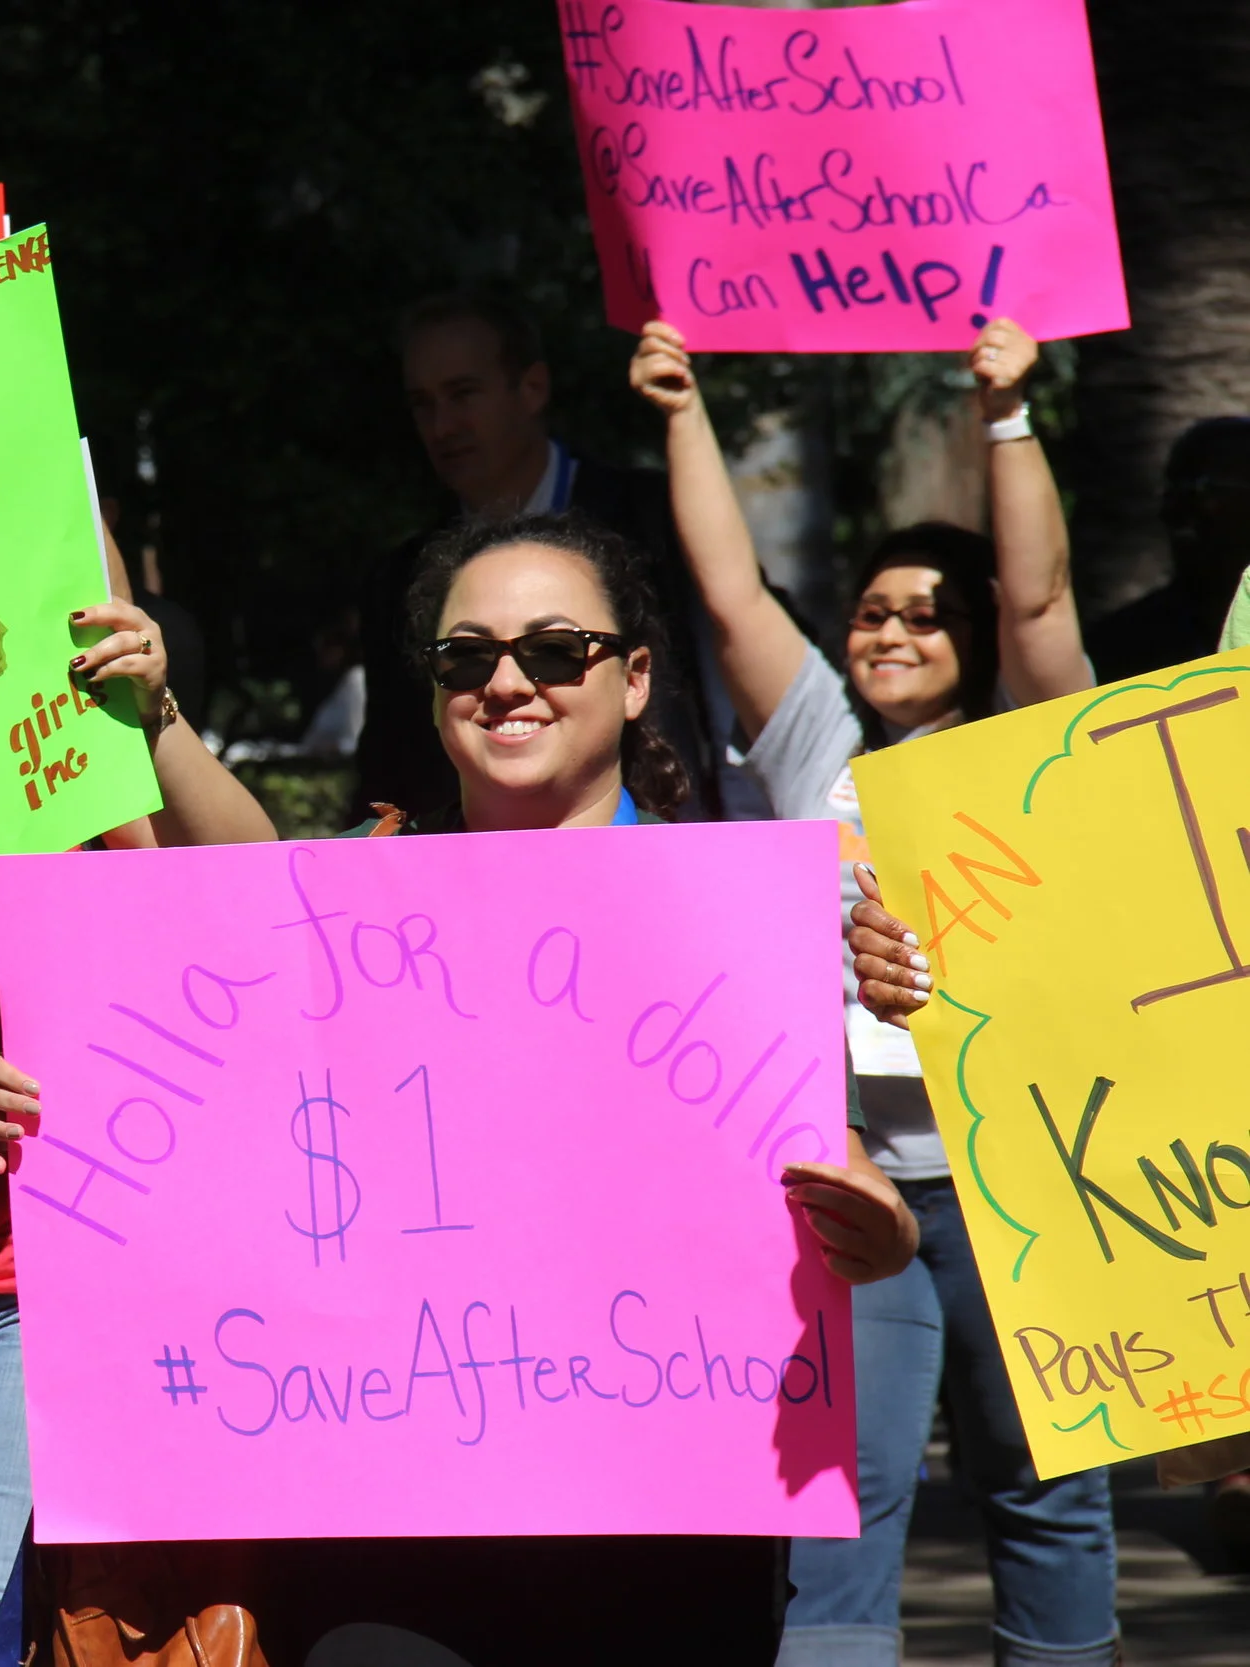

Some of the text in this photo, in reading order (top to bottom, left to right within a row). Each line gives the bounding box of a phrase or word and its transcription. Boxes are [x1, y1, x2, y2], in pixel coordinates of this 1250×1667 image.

[688, 256, 778, 317] Can
[790, 244, 1006, 331] Help!
[921, 811, 1042, 978] AN
[18, 963, 277, 1246] Holla
[527, 925, 594, 1022] a
[1028, 1076, 1250, 1264] KNO
